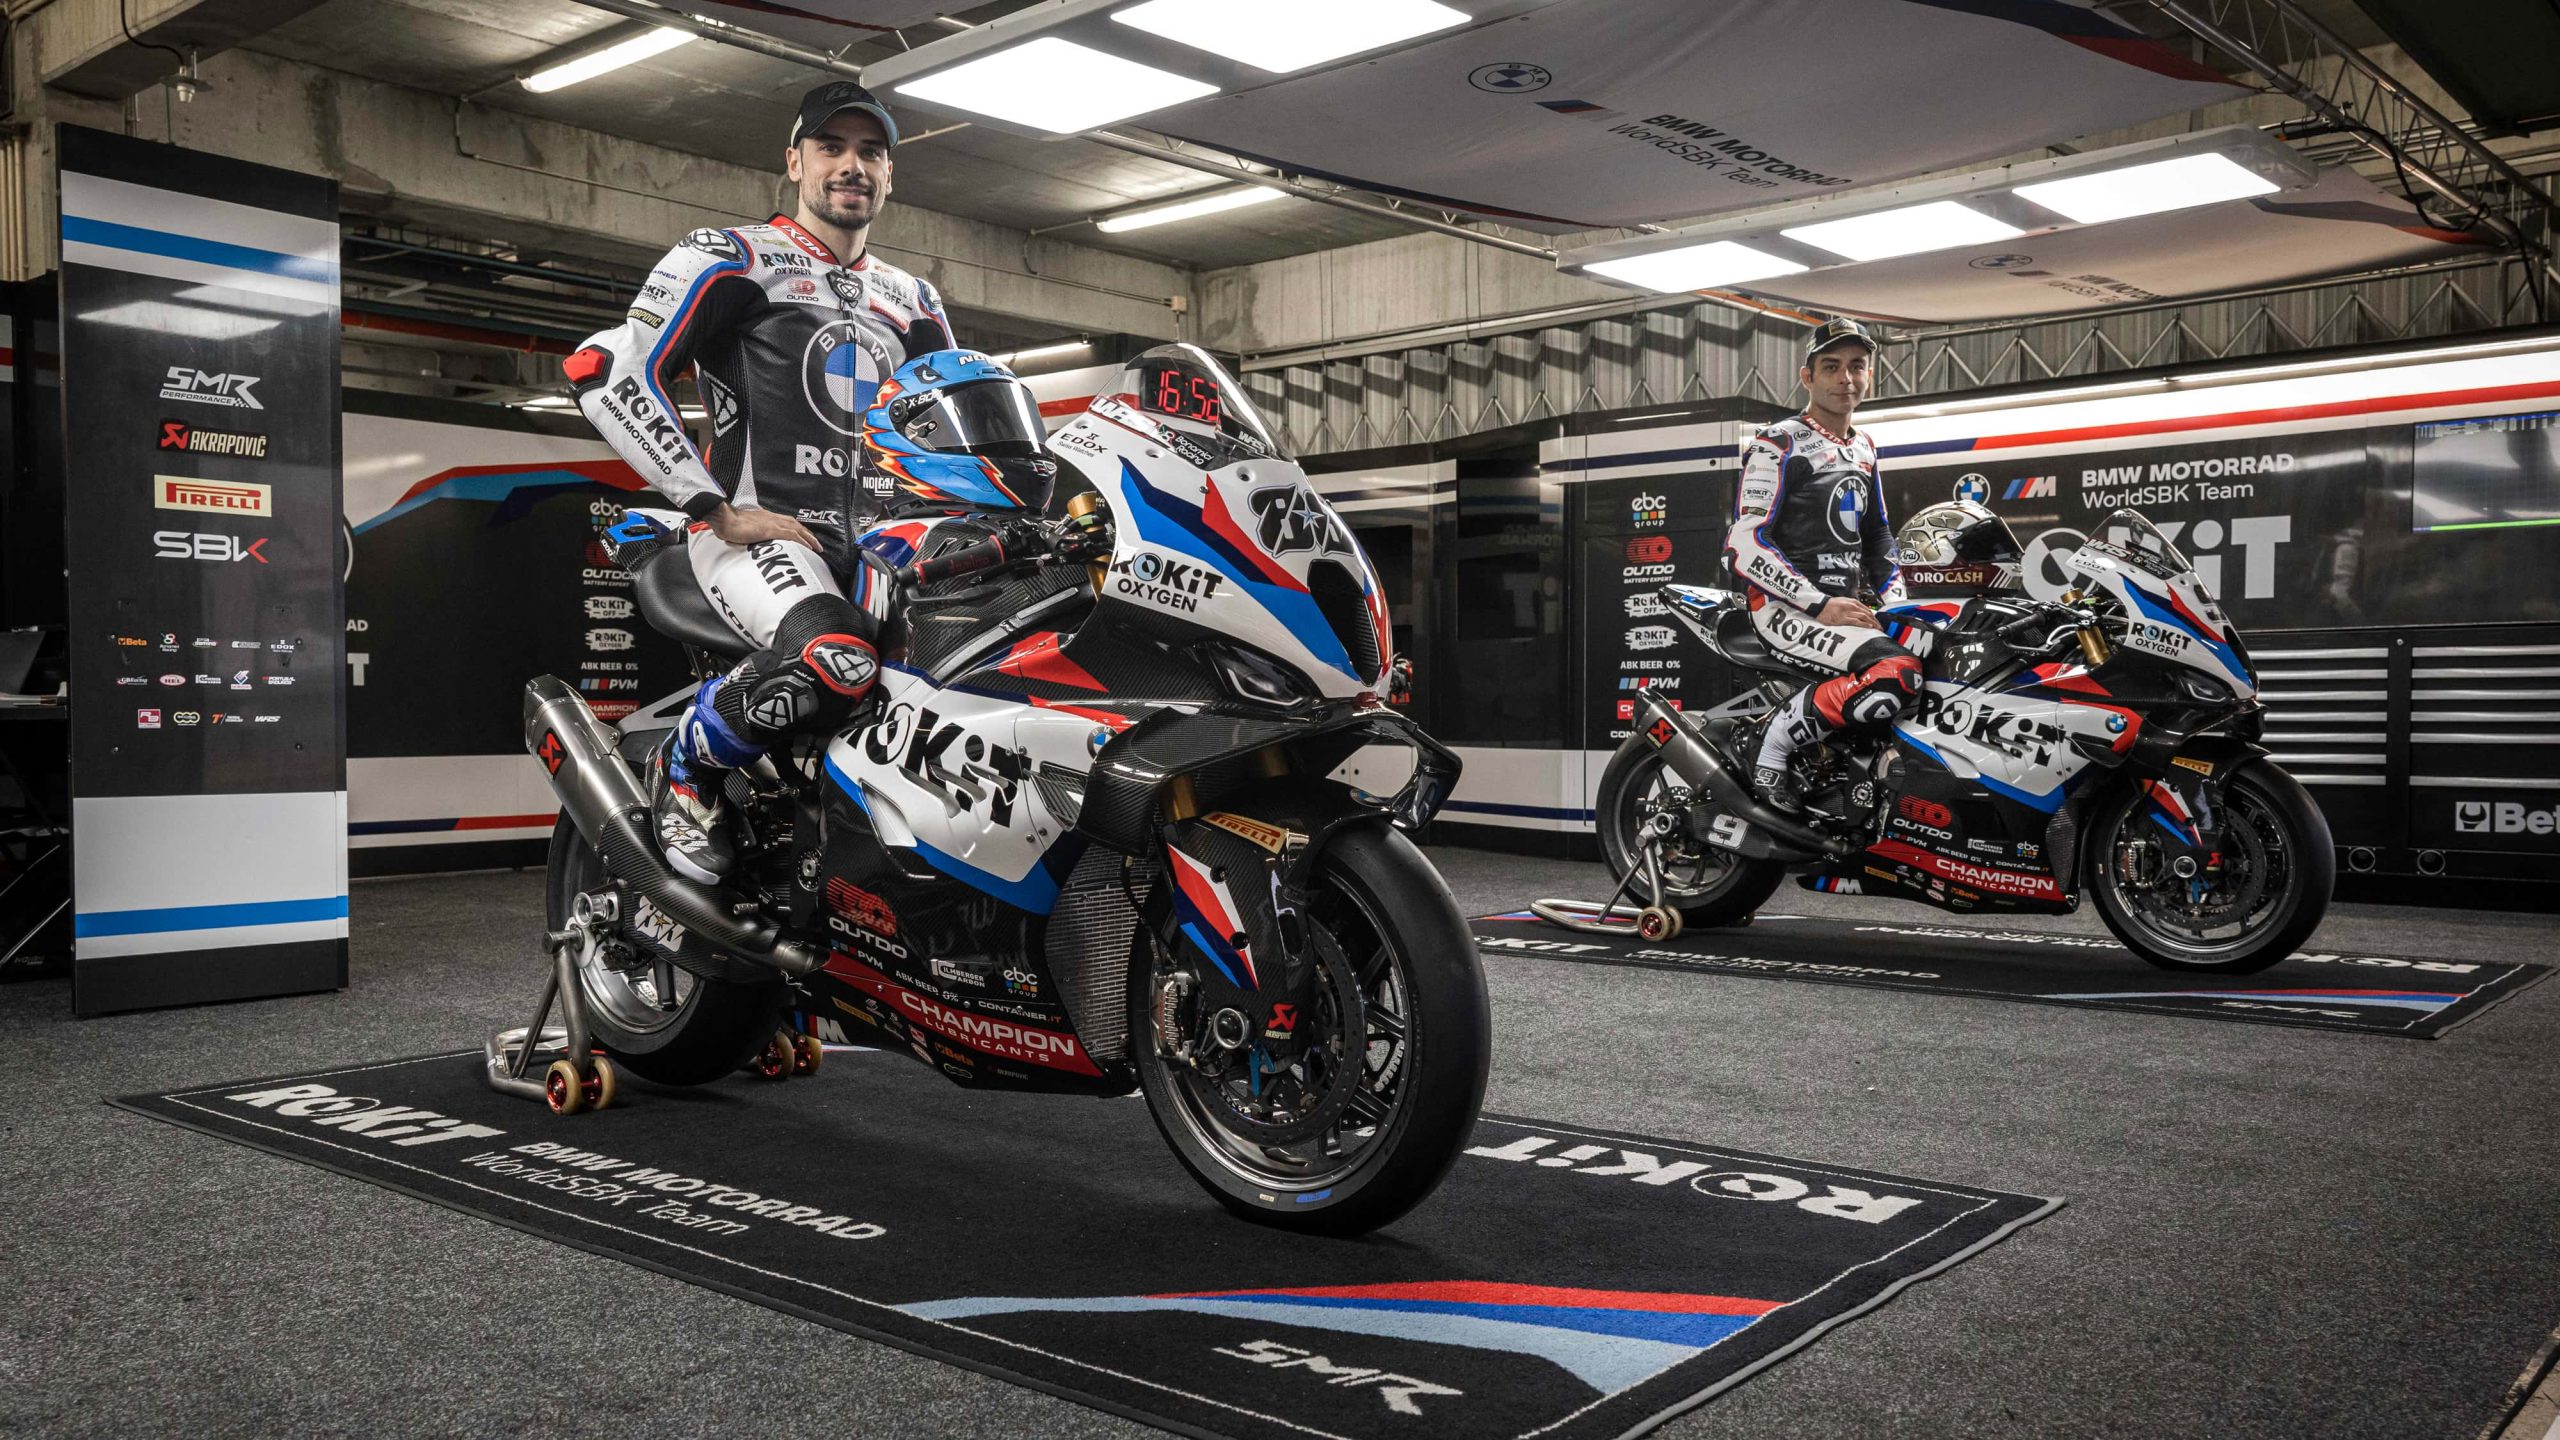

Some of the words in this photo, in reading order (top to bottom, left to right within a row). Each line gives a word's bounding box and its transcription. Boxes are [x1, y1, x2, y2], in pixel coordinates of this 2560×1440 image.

[1607, 122, 1726, 170] WorldSBK
[1721, 166, 1781, 189] Team
[1640, 114, 1726, 141] BMW
[1711, 139, 1852, 187] MOTORRAD
[775, 267, 812, 276] OXYGEN
[641, 285, 667, 299] OKiT
[786, 294, 819, 302] OUTDO
[163, 366, 264, 409] SMR
[162, 391, 233, 405] PERFORMANCE
[600, 394, 625, 424] BMW
[621, 420, 674, 476] MOTORRAD
[1060, 432, 1109, 454] EDOX
[2082, 466, 2143, 488] BMW
[2150, 454, 2294, 482] MOTORRAD
[166, 482, 262, 510] PIRELLI
[862, 476, 894, 497] NOLAN
[2082, 484, 2190, 509] WorldSBK
[2200, 480, 2254, 501] Team
[1632, 492, 1666, 511] ebc
[797, 508, 840, 526] SMR
[1635, 520, 1665, 528] group
[153, 530, 269, 564] SBK
[1623, 565, 1675, 577] OUTDO
[1650, 575, 1673, 583] EXPERT
[1746, 566, 1764, 583] BMW
[1763, 577, 1797, 600] MOTORRAD
[1117, 579, 1197, 613] OXYGEN
[126, 638, 147, 646] Beta
[2135, 638, 2179, 657] OXYGEN
[581, 662, 599, 670] ABK
[600, 662, 622, 670] BEER
[625, 662, 638, 670] 0%
[1620, 661, 1639, 669] ABK
[1640, 661, 1663, 669] BEER
[1666, 661, 1681, 669] 0%
[609, 679, 638, 690] PVM
[1649, 677, 1680, 689] PVM
[590, 704, 637, 712] HAMPION
[1208, 812, 1282, 849] PIRELLI
[1893, 817, 1952, 840] OUTDO
[1906, 836, 1927, 848] PVM
[2017, 841, 2039, 852] ebc
[1936, 858, 2054, 891] CHAMPION
[1950, 873, 2035, 895] LUBRICANTS
[829, 916, 907, 958] OUTDO
[857, 951, 884, 970] PVM
[1003, 966, 1038, 986] ebc
[914, 980, 938, 995] BEER
[1007, 988, 1037, 999] group
[902, 990, 1075, 1057] CHAMPION
[925, 1017, 1050, 1063] LUBRICANTS
[460, 1150, 648, 1206] WorldSBK
[637, 1197, 752, 1238] Team
[510, 1141, 621, 1172] BMW
[622, 1168, 889, 1241] MOTORRAD
[1212, 1338, 1464, 1418] SMR
